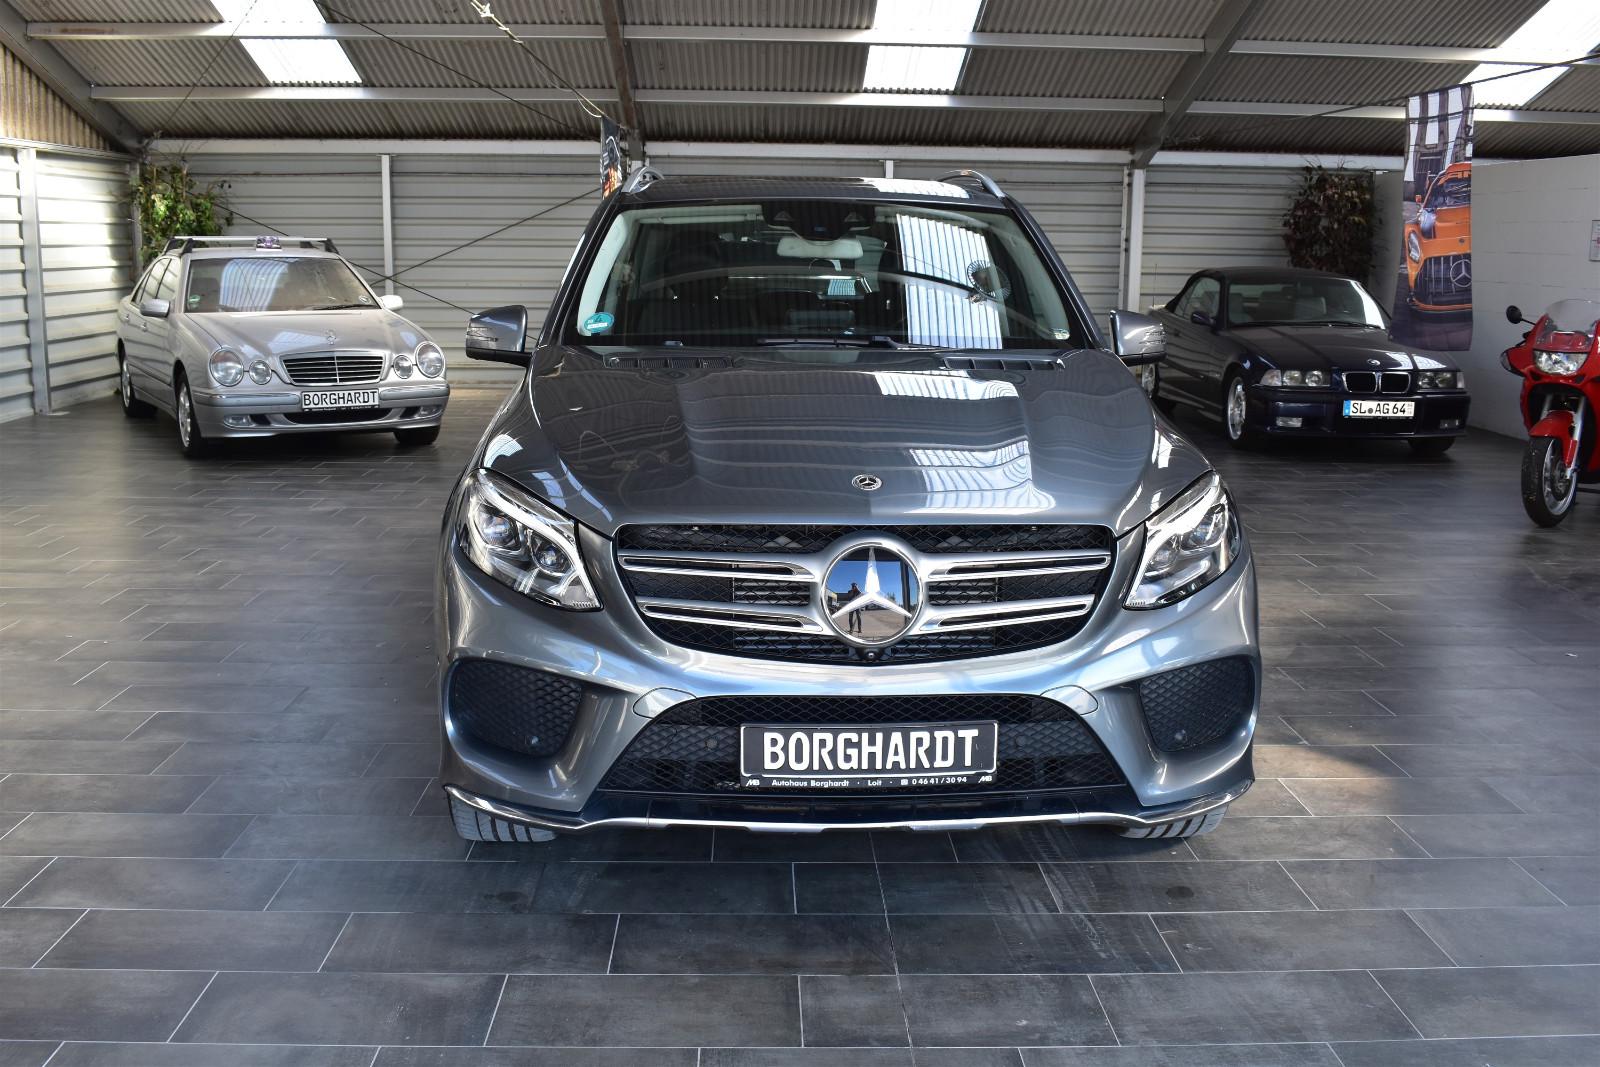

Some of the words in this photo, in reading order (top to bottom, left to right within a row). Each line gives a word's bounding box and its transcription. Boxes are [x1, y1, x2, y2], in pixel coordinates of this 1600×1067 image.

[303, 391, 378, 406] BORGHARDT
[1351, 402, 1367, 414] SL
[1374, 403, 1390, 414] AG
[1392, 403, 1406, 414] 64
[763, 729, 979, 771] BORGHARDT
[771, 779, 808, 787] Autohaus
[810, 779, 850, 788] Borghardt
[867, 779, 882, 787] Loit
